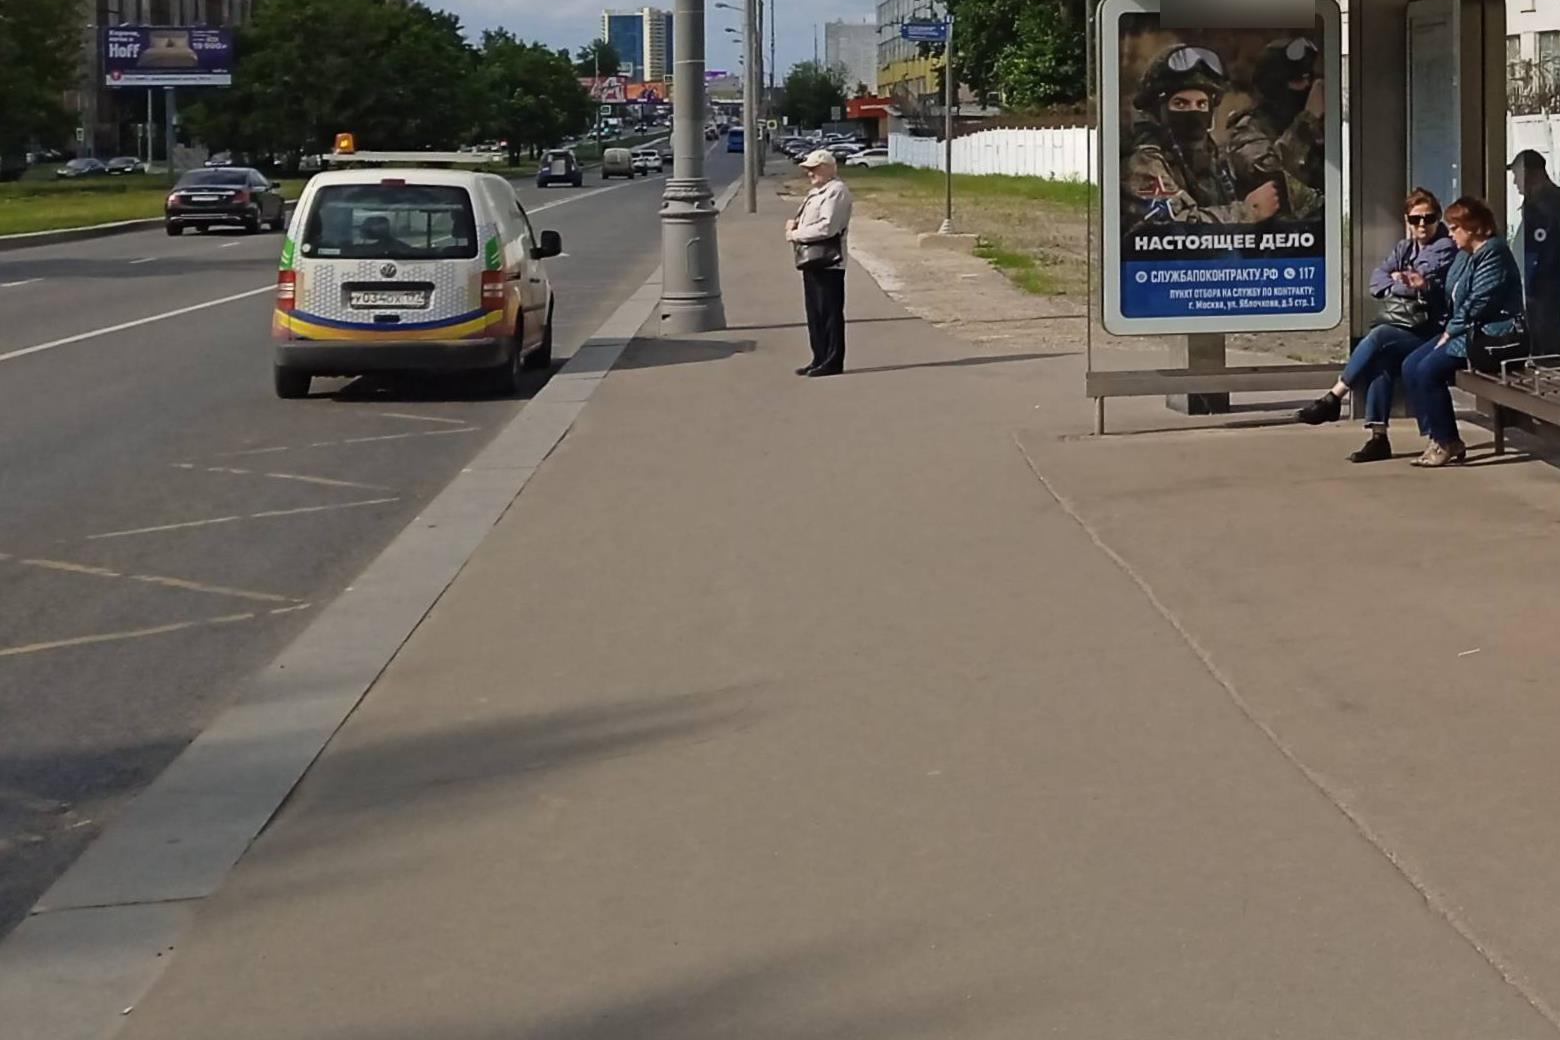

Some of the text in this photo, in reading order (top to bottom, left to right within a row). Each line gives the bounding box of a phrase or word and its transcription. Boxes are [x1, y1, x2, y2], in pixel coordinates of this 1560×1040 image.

[108, 43, 141, 58] Hoff
[1135, 233, 1315, 250] НАСТОЯЩЕЕ ДЕЛО
[1150, 267, 1315, 283] СЛУЖБАПОКОНТРАКТУ.РФ 117
[1169, 289, 1193, 299] ПУНКТ
[1194, 288, 1221, 298] ОТБОРА
[1222, 289, 1232, 297] НА
[1232, 287, 1261, 297] СЛУЖБУ
[1262, 287, 1272, 297] ПО
